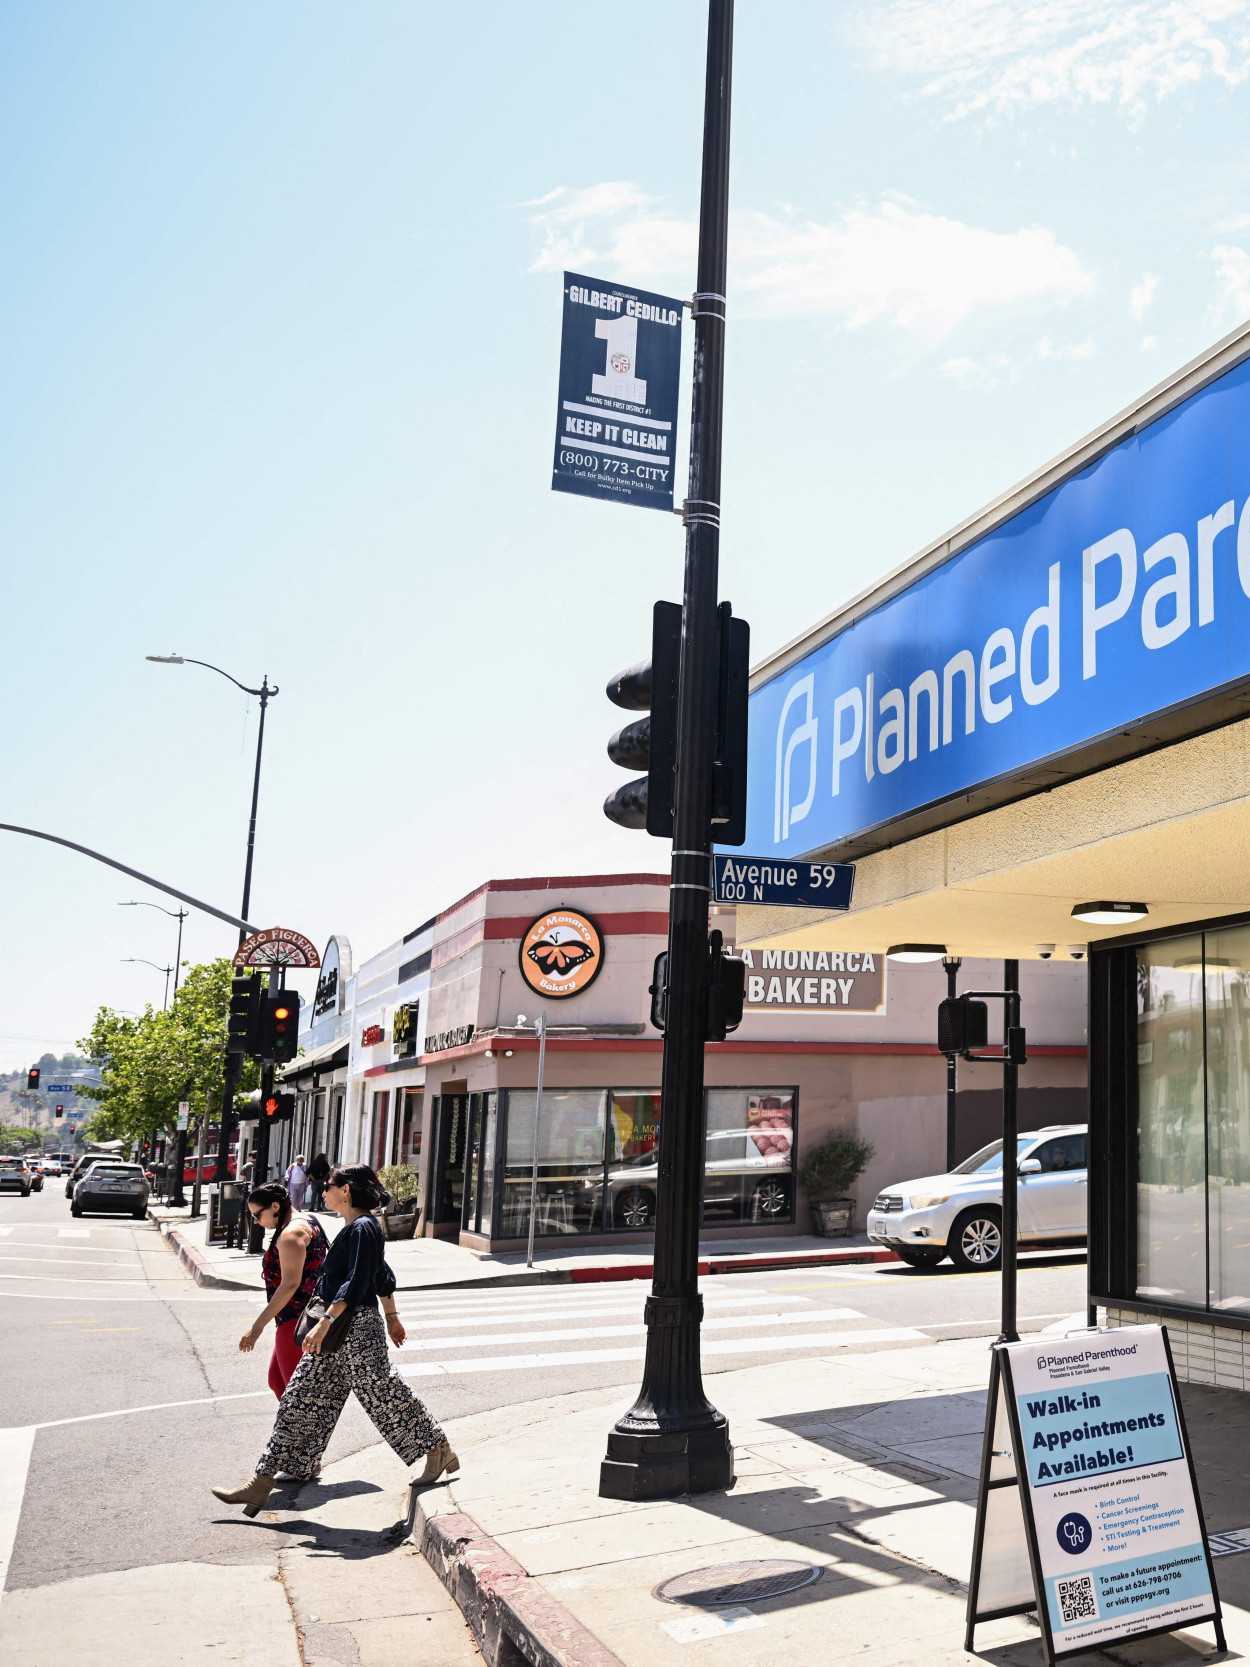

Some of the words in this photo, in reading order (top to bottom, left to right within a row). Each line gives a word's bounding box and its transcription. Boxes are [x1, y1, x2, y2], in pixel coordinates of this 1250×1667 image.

[569, 285, 624, 313] GILBERT
[626, 300, 678, 327] CEDILLO
[591, 314, 647, 405] 1
[603, 399, 613, 407] THE
[613, 401, 625, 410] FIRST
[625, 403, 645, 414] DISTRICT
[565, 416, 602, 438] KEEP
[604, 424, 620, 442] IT
[622, 428, 667, 451] CLEAN
[560, 450, 599, 471] (800)
[603, 459, 669, 482] 773-CITY
[574, 469, 586, 477] Call
[587, 471, 597, 479] for
[597, 473, 615, 482] Bulky
[616, 476, 631, 486] Item
[631, 479, 645, 488] Pick
[832, 561, 1060, 797] Planned
[721, 858, 798, 886] Avenue
[809, 865, 836, 889] 59
[720, 883, 746, 900] 100
[753, 885, 764, 901] N
[531, 926, 546, 941] La
[546, 915, 592, 941] Monarca
[235, 933, 267, 966] PASEO
[271, 930, 318, 967] FIGUEROA
[762, 950, 876, 973] MONARCA
[539, 978, 576, 991] Bakery
[747, 975, 855, 1005] BAKERY
[1047, 1352, 1084, 1367] Planned
[1085, 1344, 1137, 1361] Parenthood
[1026, 1391, 1101, 1418] Walk-in
[1033, 1412, 1166, 1451] Appointments
[1037, 1445, 1134, 1480] Available!
[1070, 1487, 1083, 1495] mask
[1088, 1481, 1109, 1491] required
[1100, 1500, 1115, 1508] Birth
[1116, 1494, 1140, 1505] Control
[1101, 1509, 1124, 1519] Cancer
[1125, 1502, 1159, 1515] Screenings
[1103, 1518, 1139, 1530] Emergency
[1140, 1507, 1184, 1522] Contraception
[1106, 1533, 1116, 1541] STI
[1117, 1528, 1140, 1539] Testing
[1148, 1520, 1180, 1532] Treatment
[1108, 1543, 1127, 1552] More!
[1110, 1572, 1129, 1582] make
[1136, 1565, 1157, 1576] future
[1158, 1555, 1203, 1572] appointment:
[1102, 1587, 1115, 1596] call
[1125, 1583, 1132, 1591] at
[1133, 1571, 1182, 1588] 626-798-0706
[1115, 1596, 1129, 1606] visit
[1131, 1587, 1170, 1604] pppsgv.org
